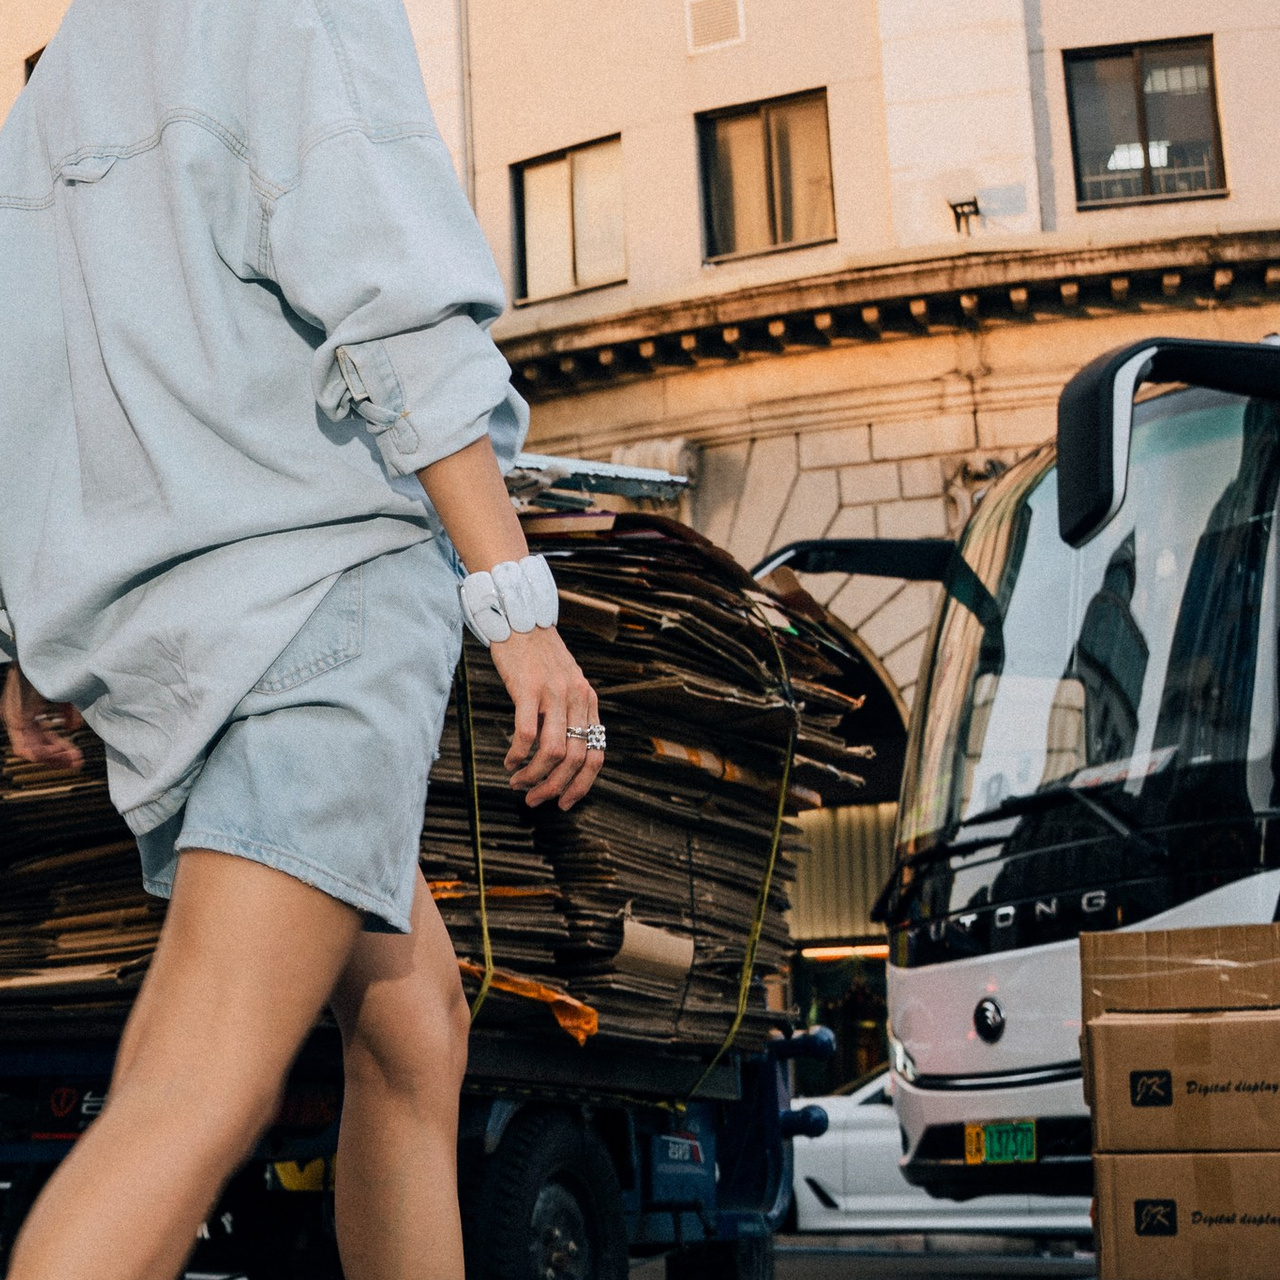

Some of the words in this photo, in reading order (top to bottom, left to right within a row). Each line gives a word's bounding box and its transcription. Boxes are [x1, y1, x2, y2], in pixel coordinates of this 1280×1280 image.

[1186, 1080, 1232, 1097] Digital
[1234, 1080, 1279, 1094] display
[1191, 1211, 1237, 1227] Digital
